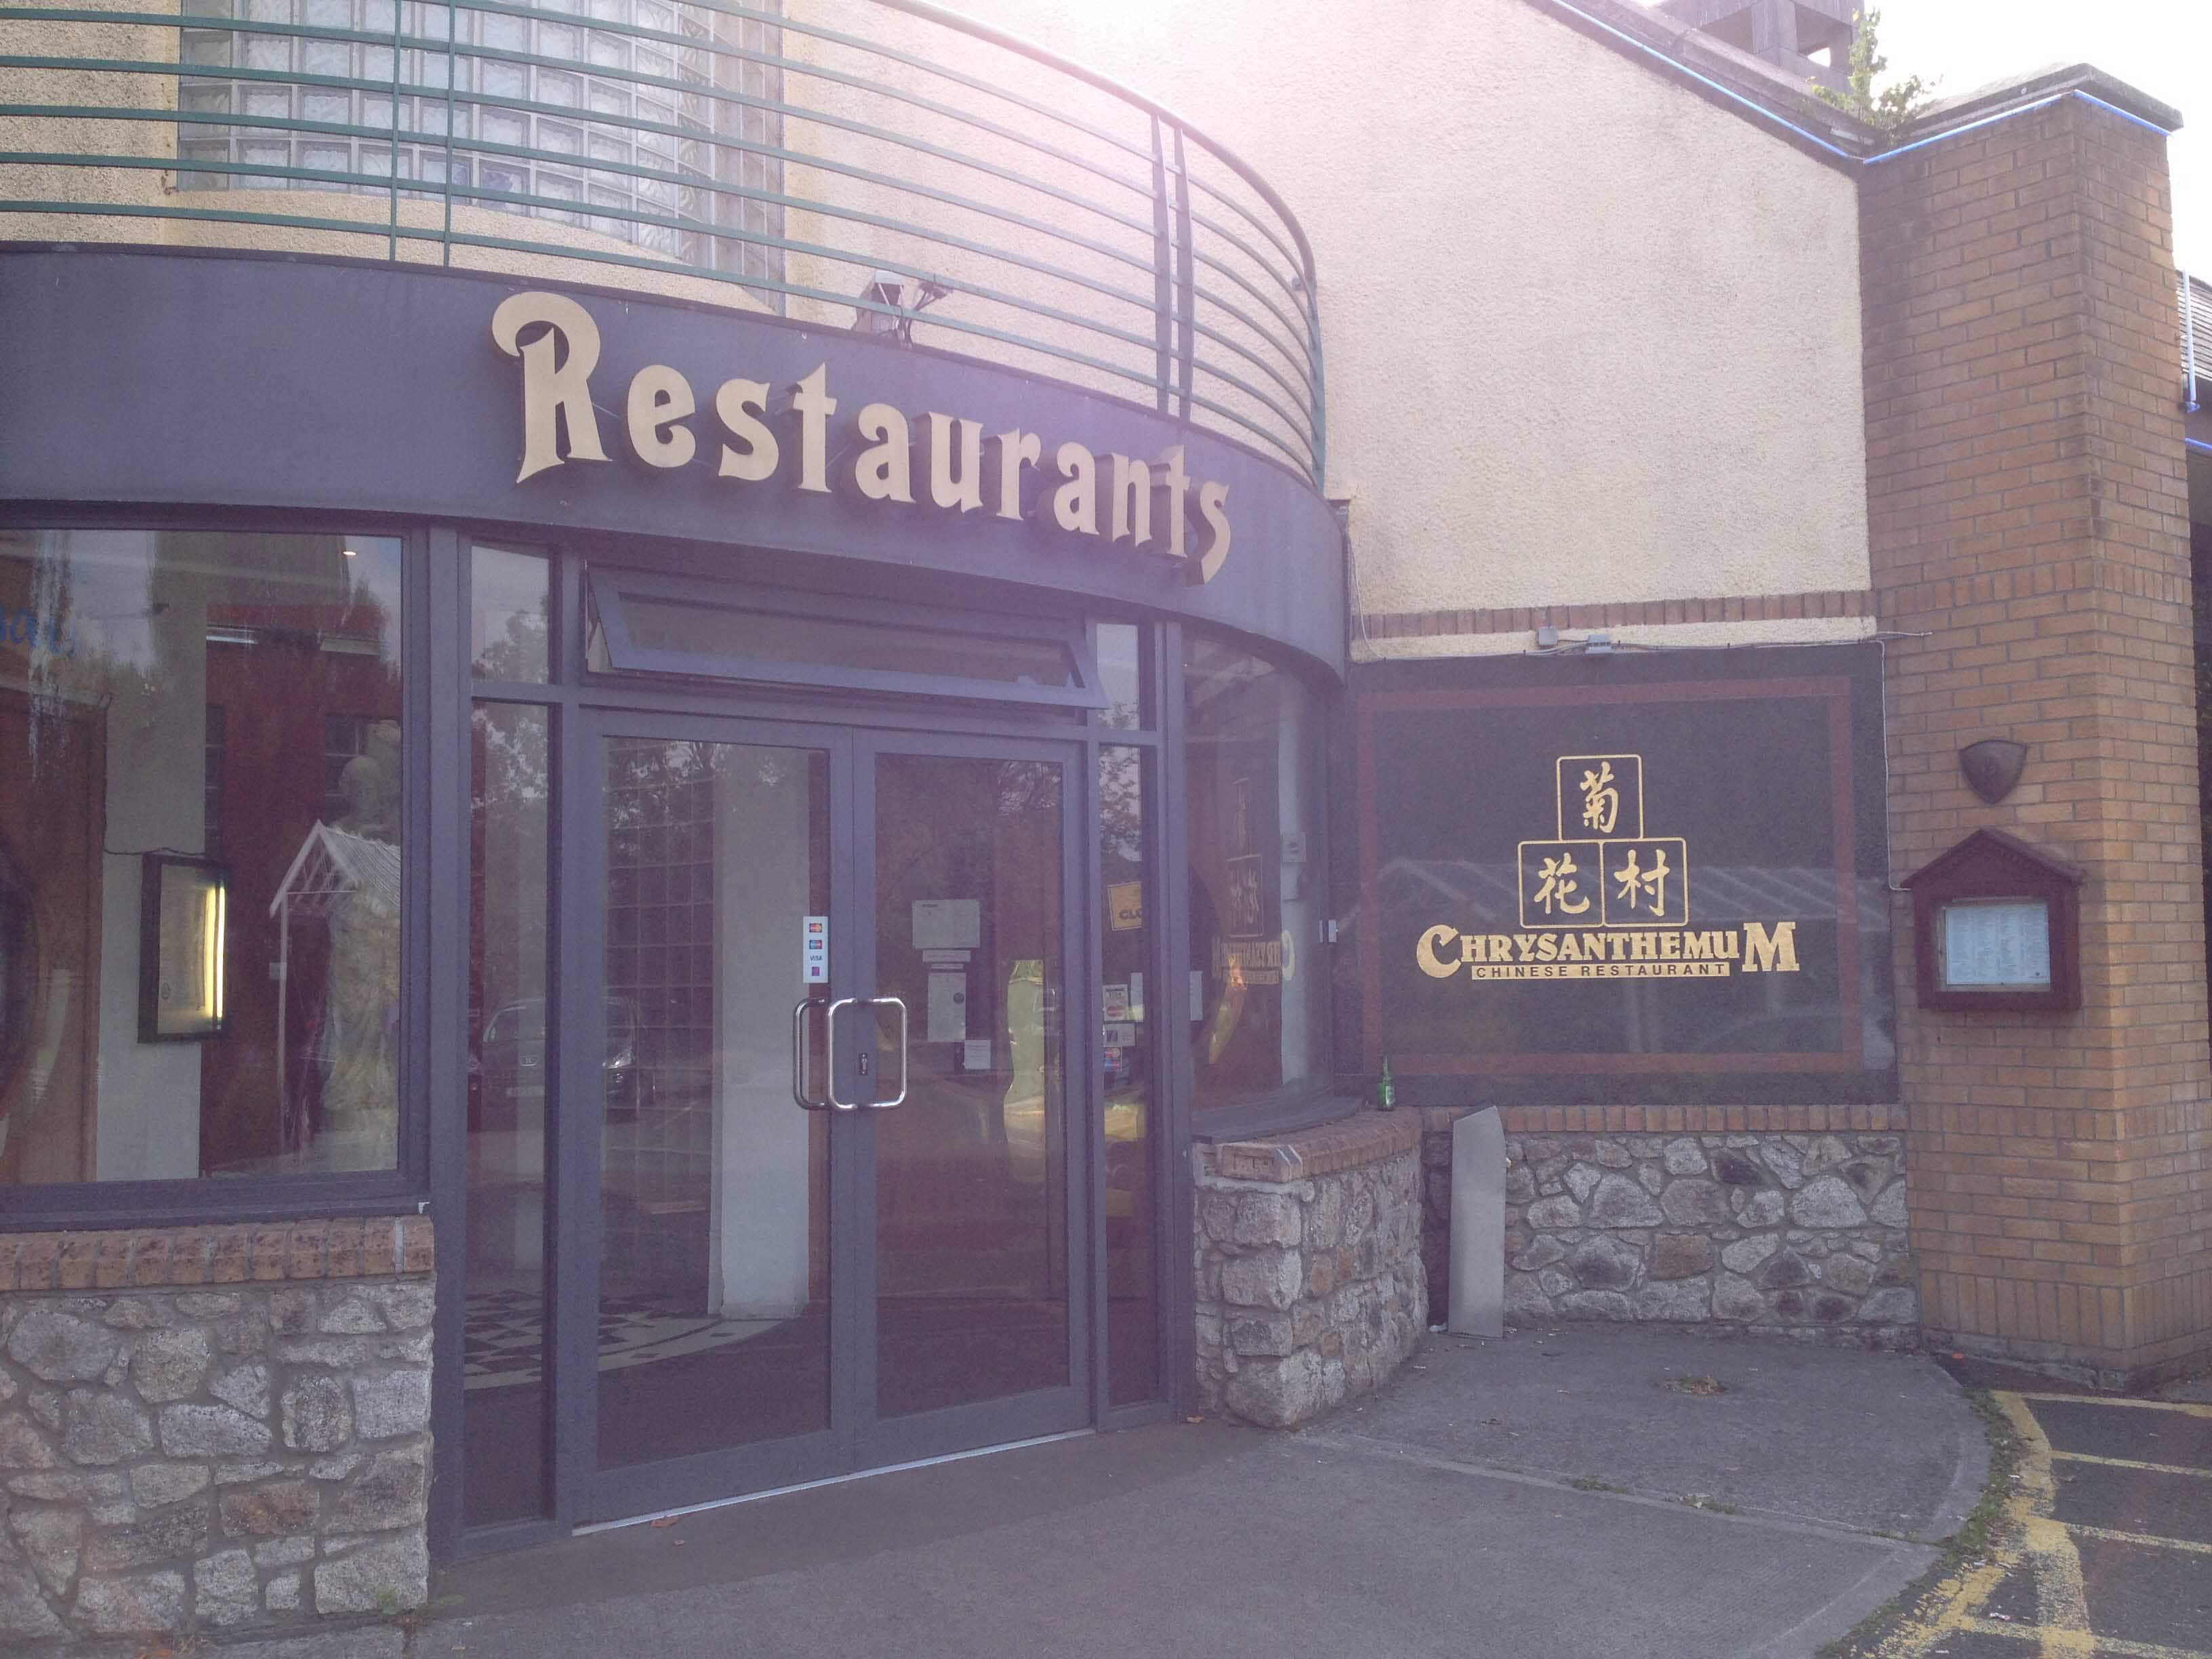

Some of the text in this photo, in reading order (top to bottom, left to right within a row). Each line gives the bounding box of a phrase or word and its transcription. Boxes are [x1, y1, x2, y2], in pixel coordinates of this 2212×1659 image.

[491, 291, 1232, 586] Restaurants
[1580, 761, 1620, 834] 菊
[1416, 921, 1801, 979] CHRYSANTHEMUM
[1477, 963, 1725, 978] CHINESE RESTAURANT
